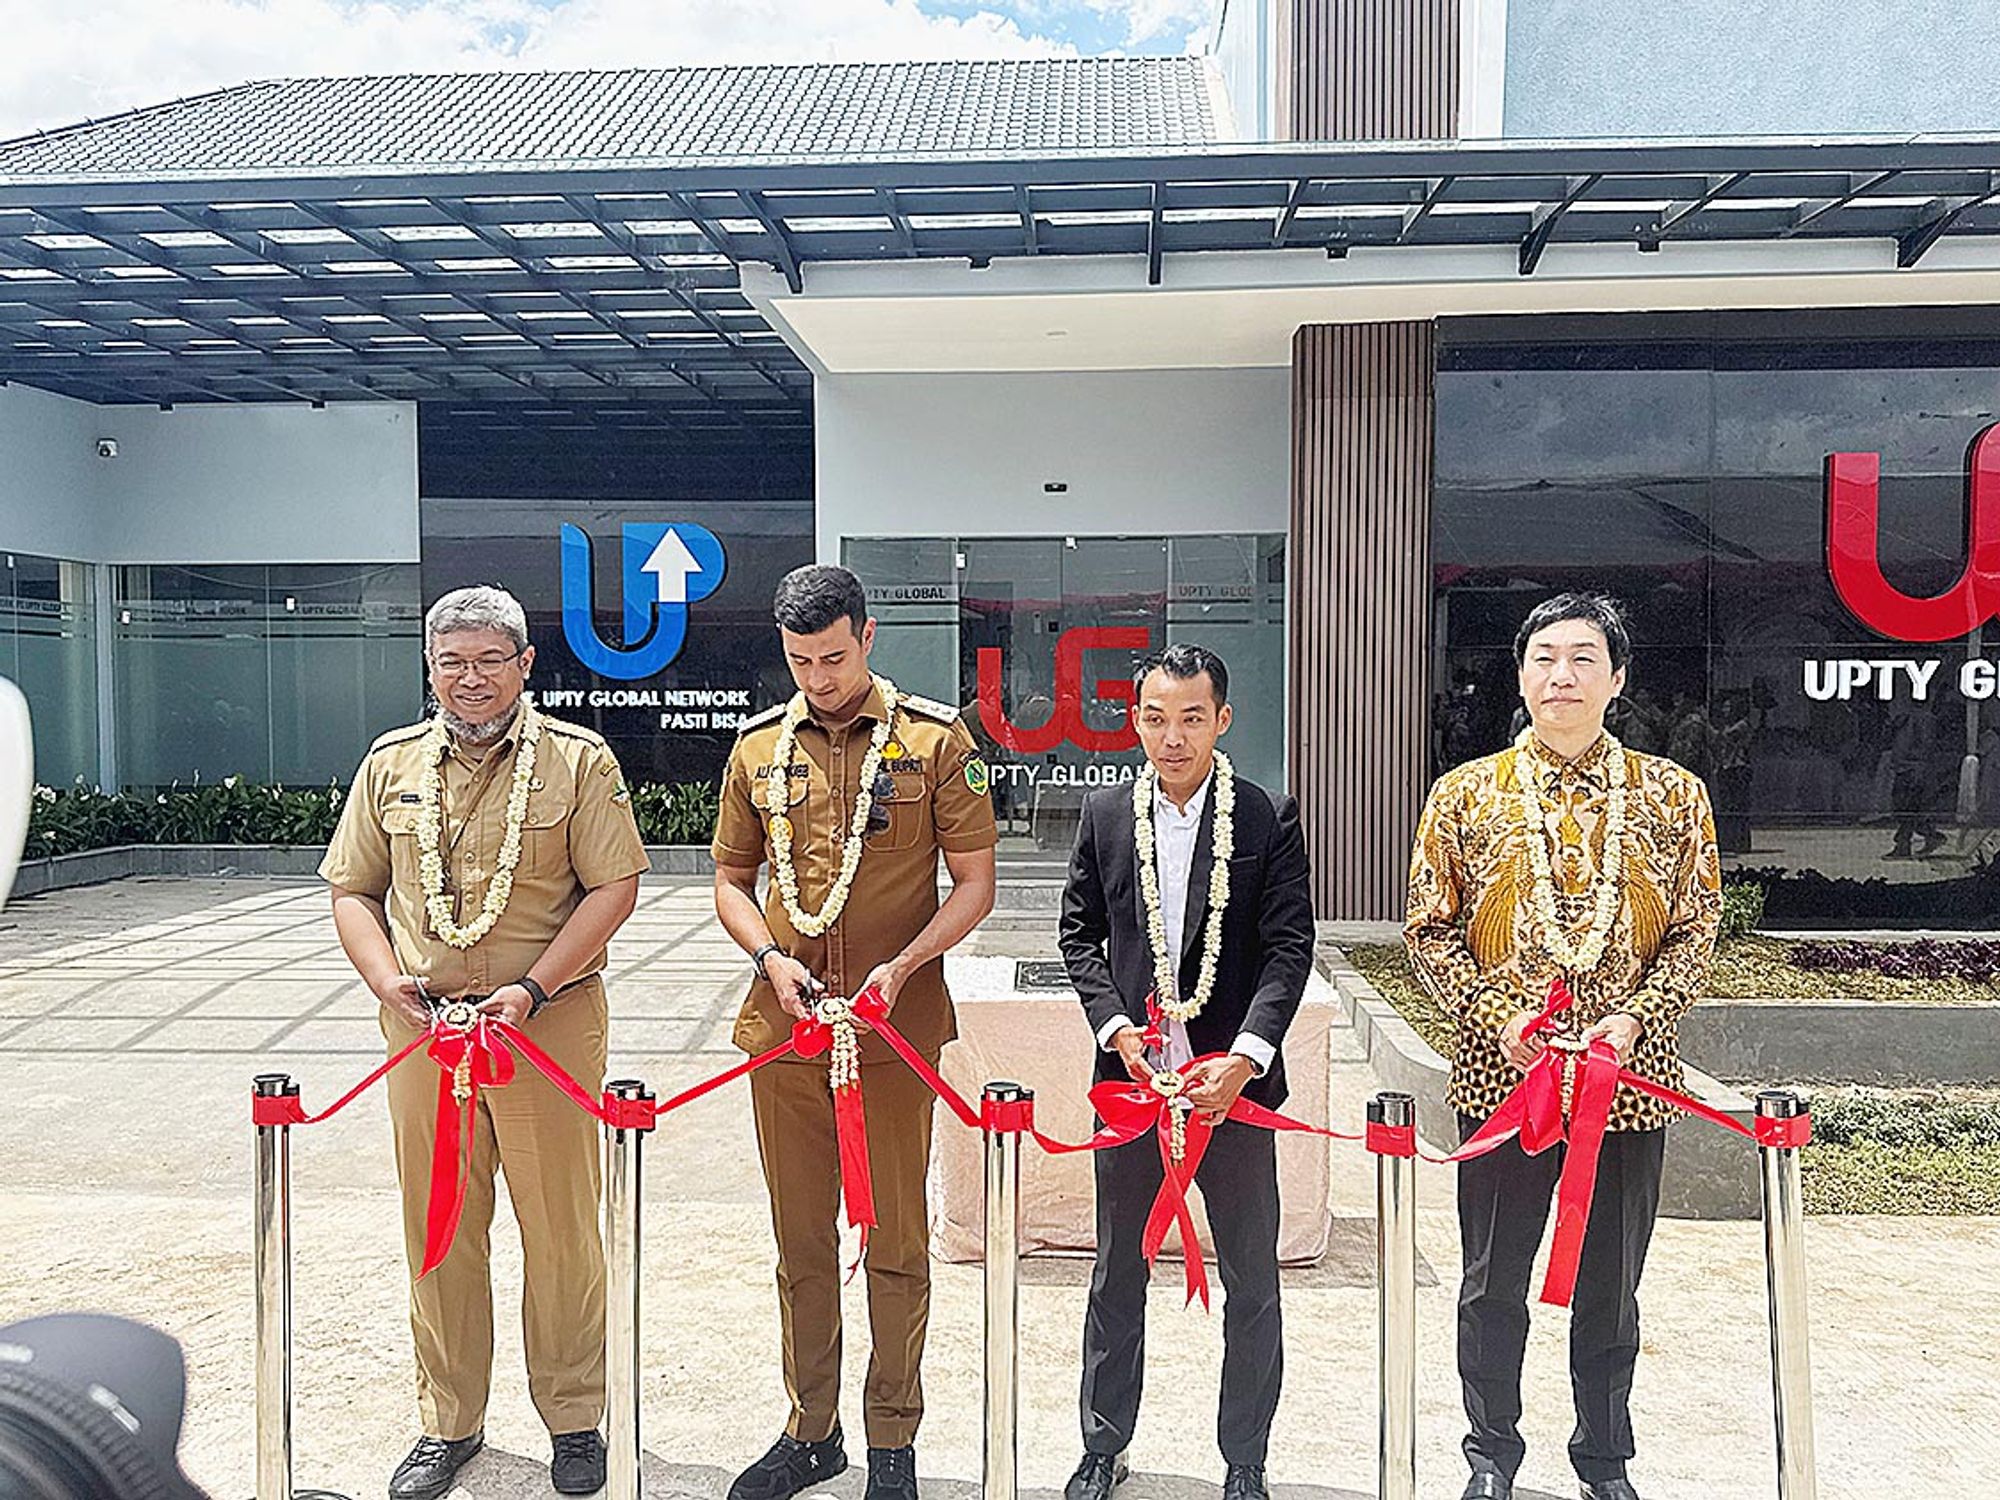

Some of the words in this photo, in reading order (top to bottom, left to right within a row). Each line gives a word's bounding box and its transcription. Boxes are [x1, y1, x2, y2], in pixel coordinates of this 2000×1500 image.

[1823, 421, 2000, 643] U
[895, 587, 946, 599] GLOBAL
[1804, 660, 1941, 701] UPTY
[1959, 658, 2000, 700] G
[543, 690, 585, 708] UPTY
[589, 690, 661, 708] GLOBAL
[665, 690, 750, 708] NETWORK
[660, 713, 708, 730] PASTI
[990, 764, 1041, 787] PTY
